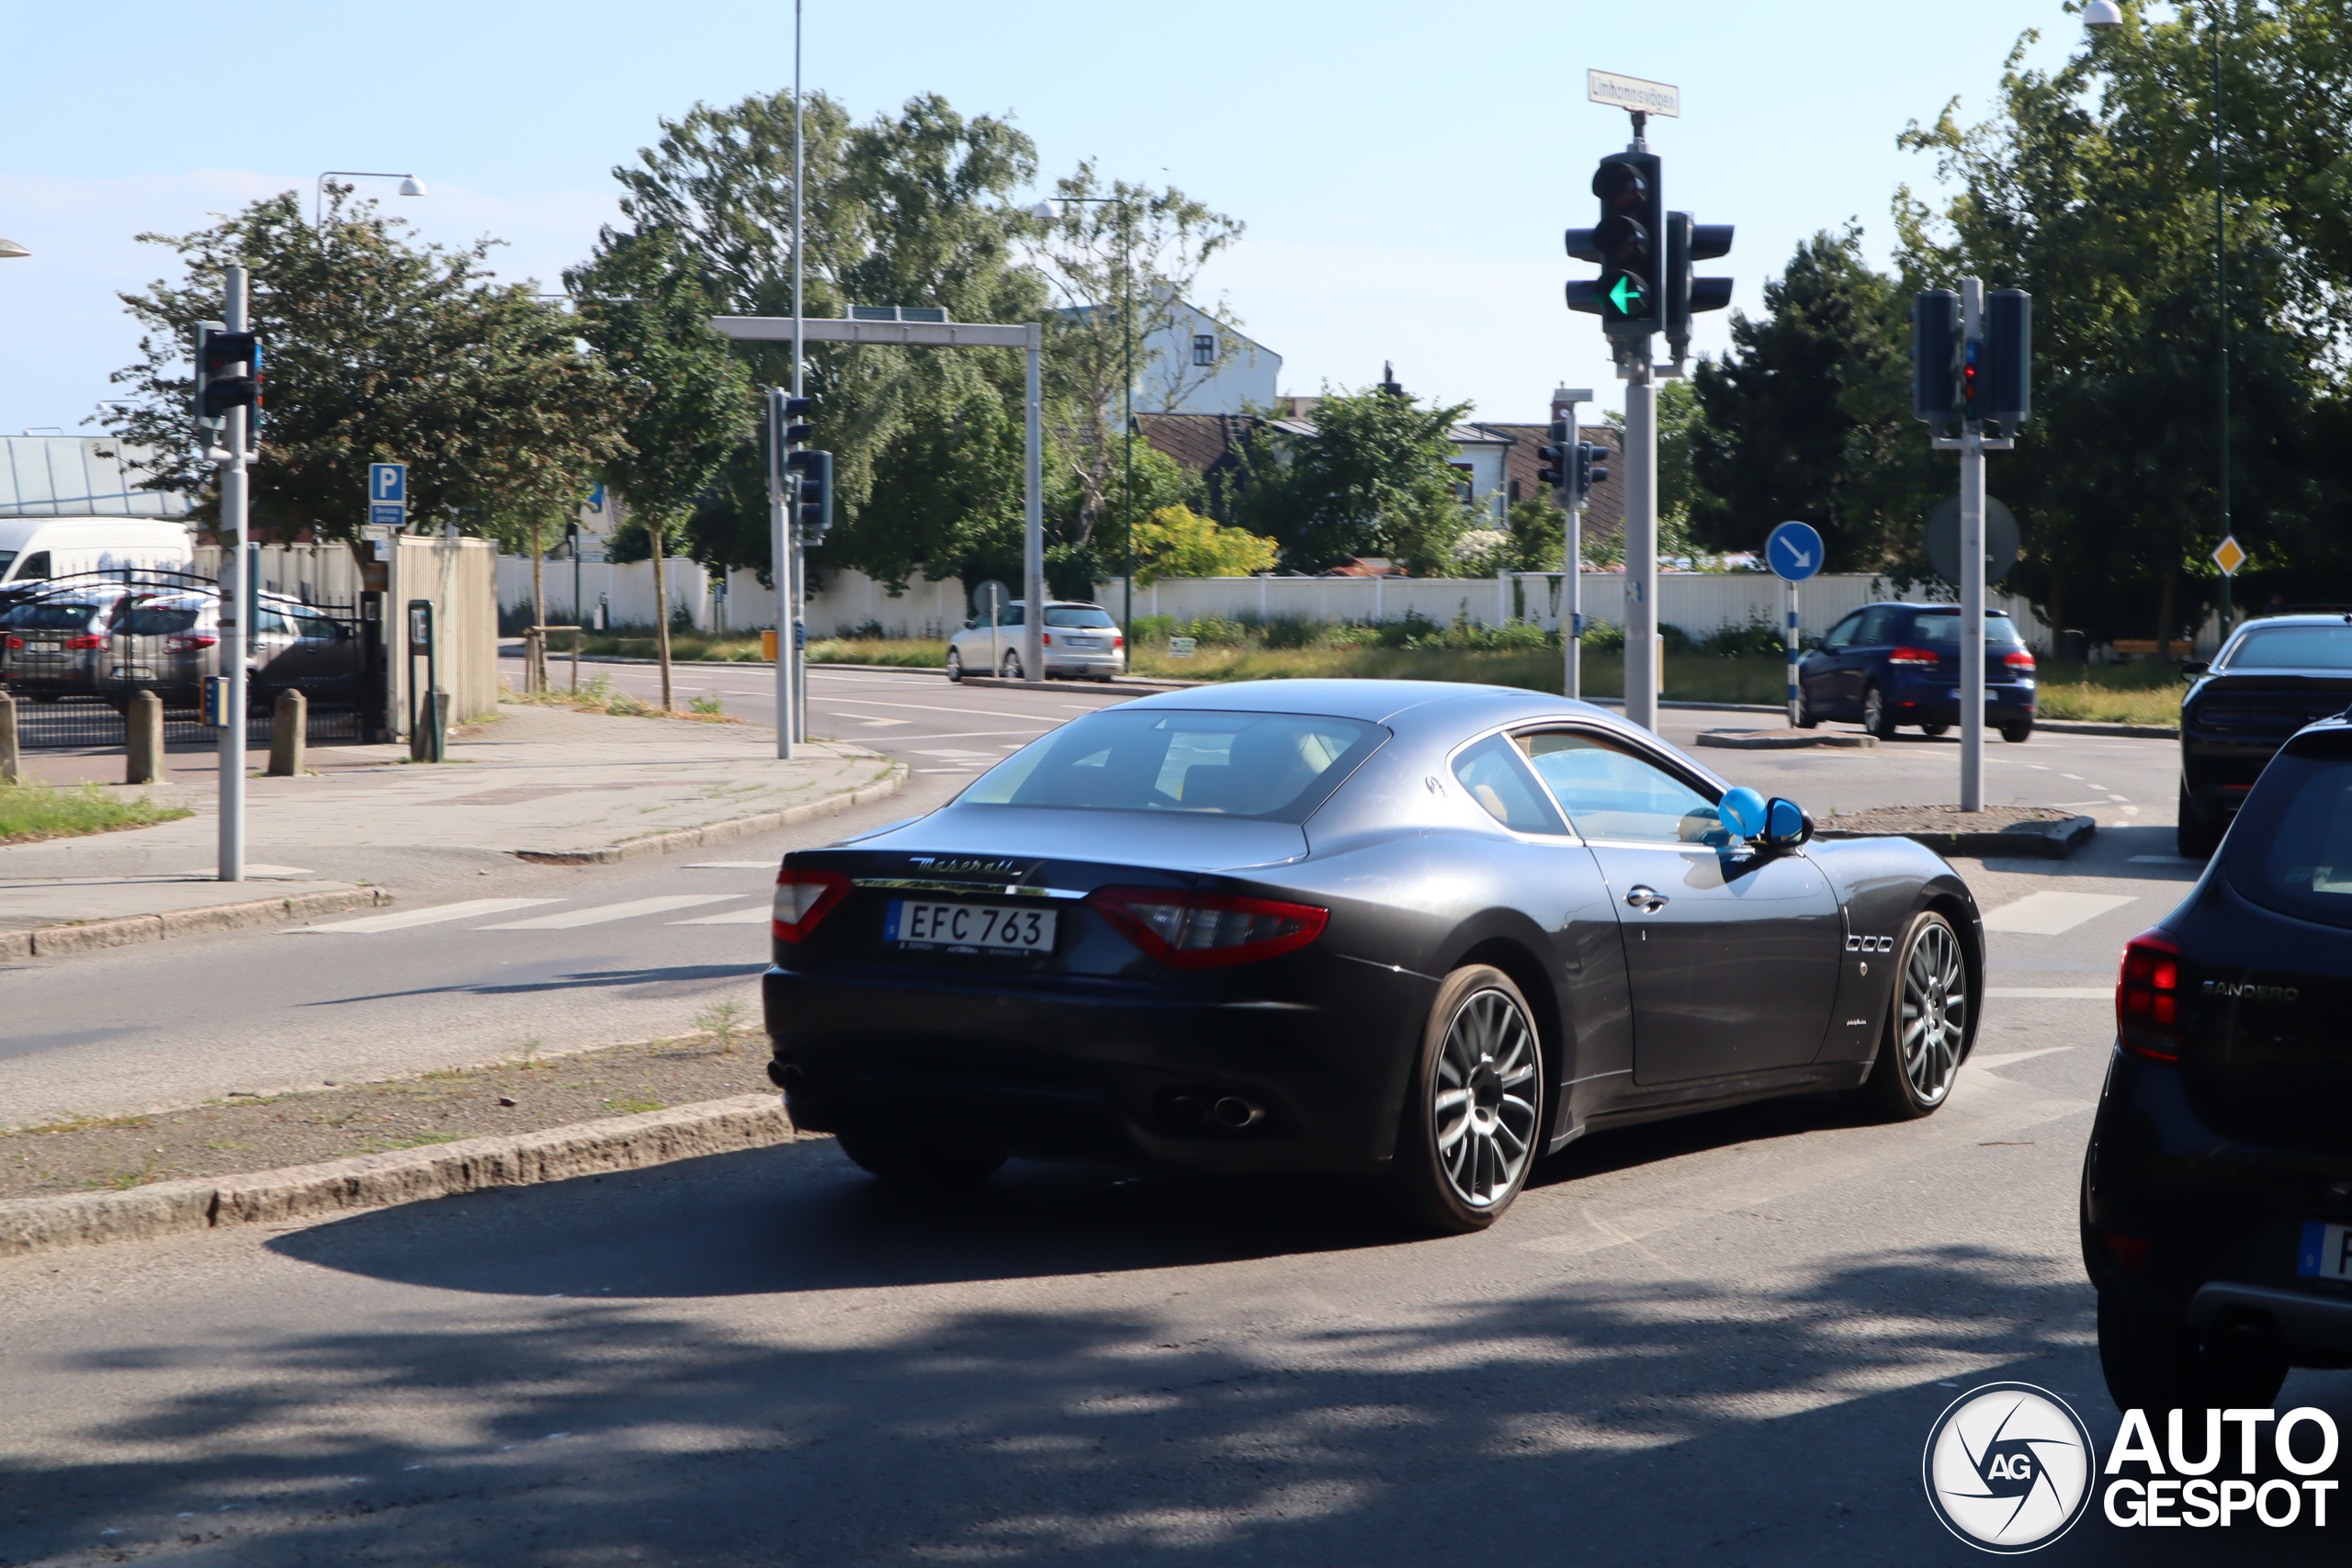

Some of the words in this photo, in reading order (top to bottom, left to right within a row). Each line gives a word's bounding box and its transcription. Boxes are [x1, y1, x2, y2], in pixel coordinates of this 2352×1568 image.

[1591, 75, 1675, 111] Limhamnsvägen
[379, 468, 398, 498] P
[910, 857, 1023, 875] Maserati
[910, 906, 969, 940] EFC
[980, 909, 1042, 945] 763
[2202, 980, 2299, 1000] SANDERO
